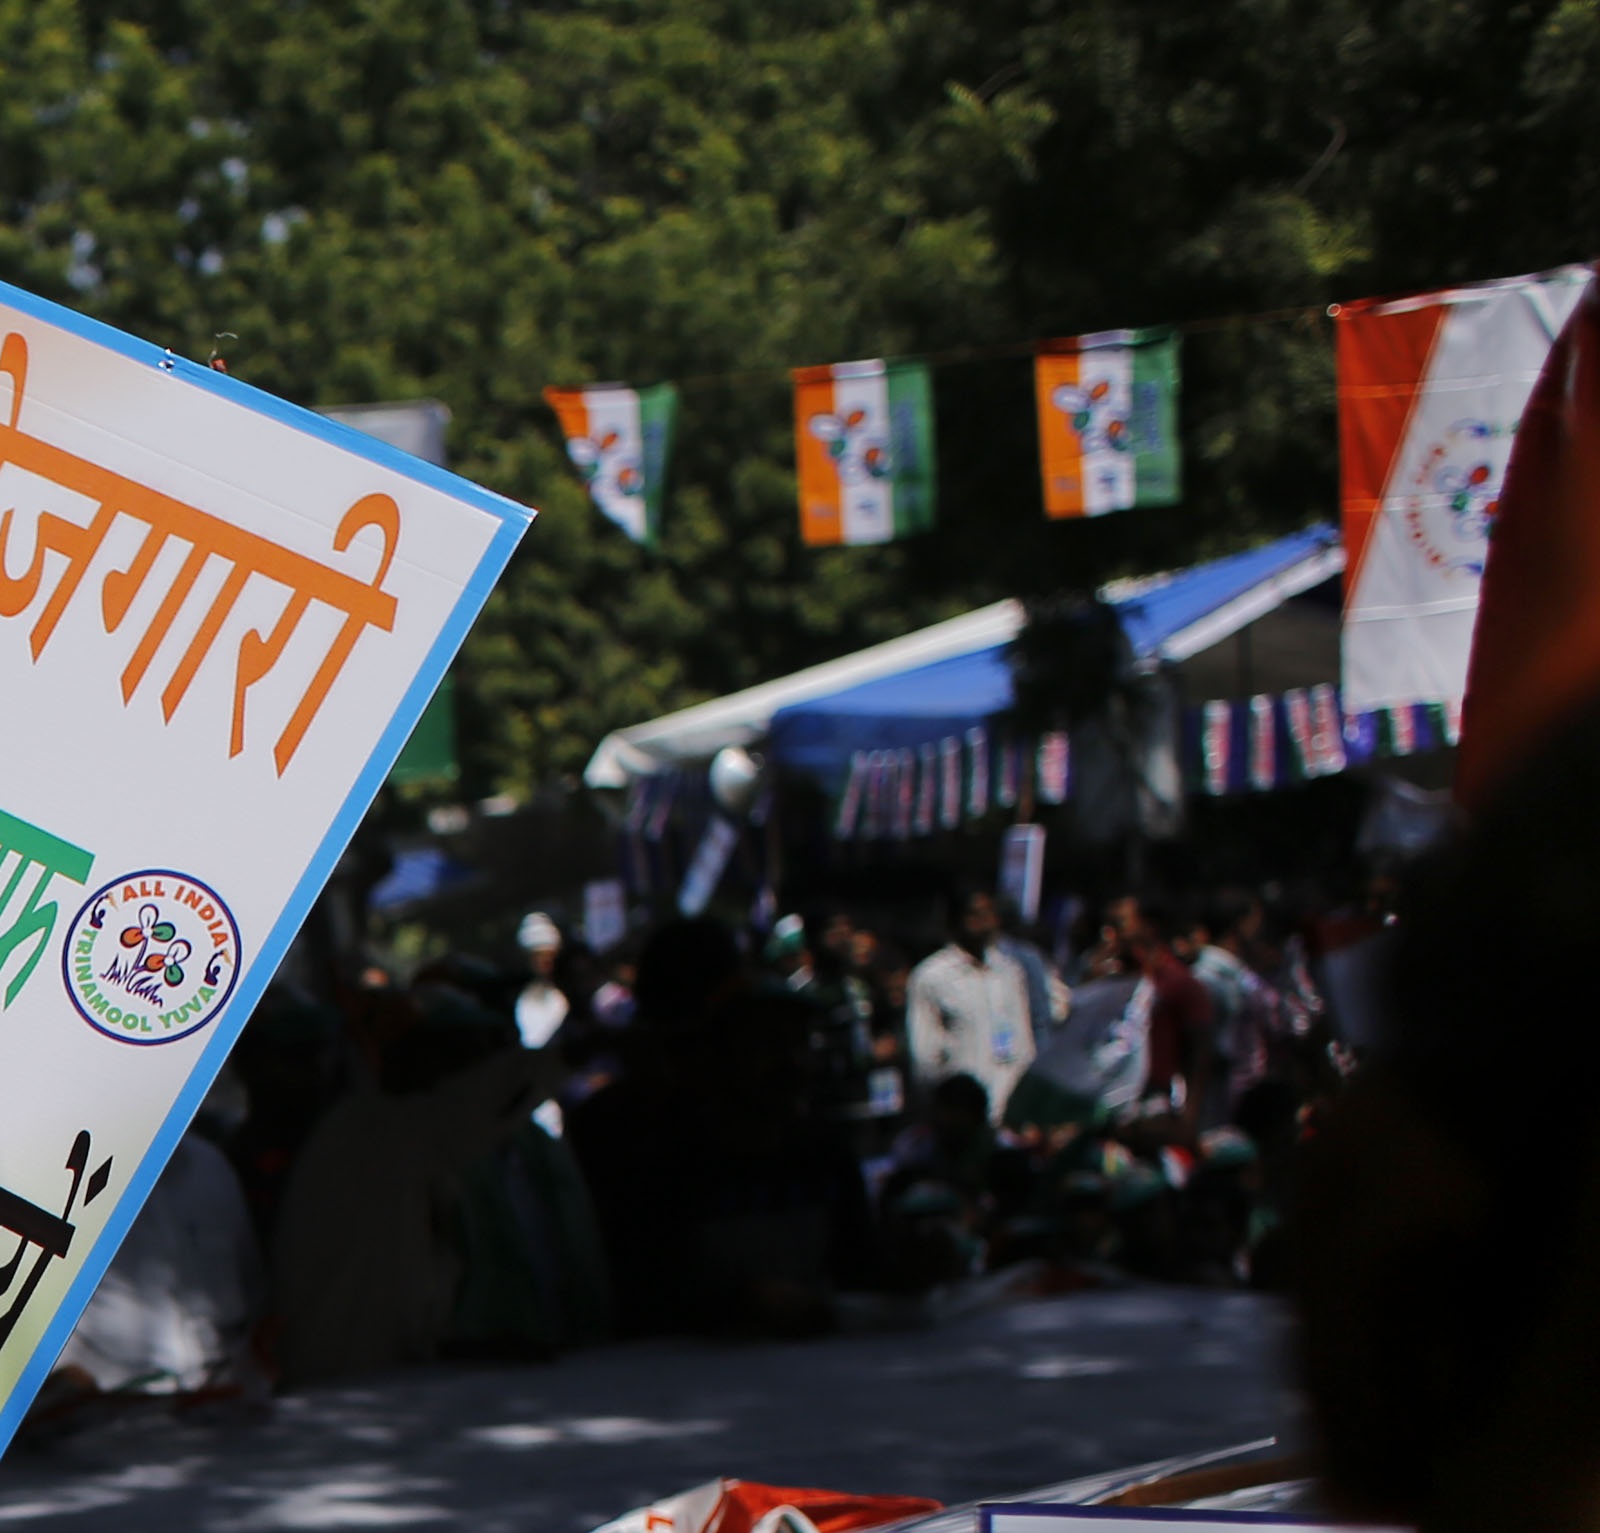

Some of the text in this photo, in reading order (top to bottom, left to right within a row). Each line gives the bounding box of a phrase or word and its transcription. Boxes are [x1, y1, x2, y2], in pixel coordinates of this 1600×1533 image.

[122, 880, 228, 947] ALL INDIA
[75, 929, 216, 1032] TRINAMOOL YUVA
